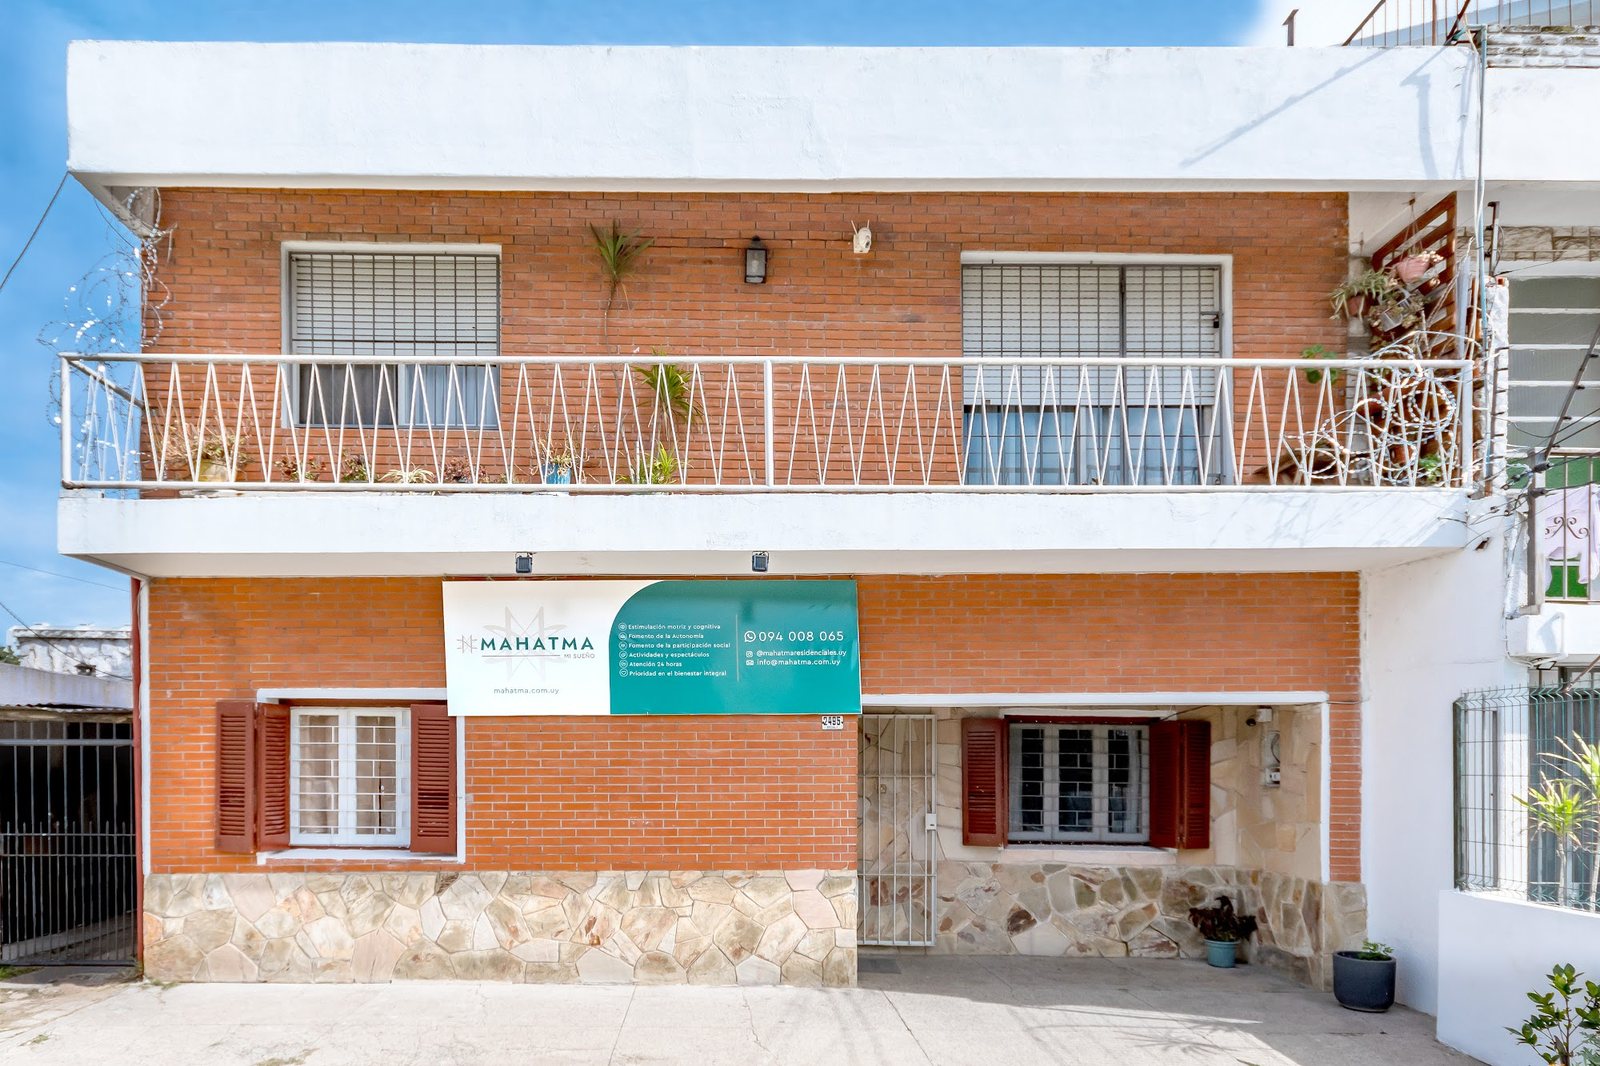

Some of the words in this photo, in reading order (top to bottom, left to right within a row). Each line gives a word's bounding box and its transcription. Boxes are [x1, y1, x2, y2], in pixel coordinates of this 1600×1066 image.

[758, 631, 783, 642] 094
[788, 631, 814, 642] 008
[819, 631, 844, 641] 065
[480, 636, 594, 651] MAHATMA
[756, 649, 846, 657] @mahatmaresidenciales.uy
[493, 687, 559, 695] mahatma.com.uy
[823, 716, 841, 726] 2495
